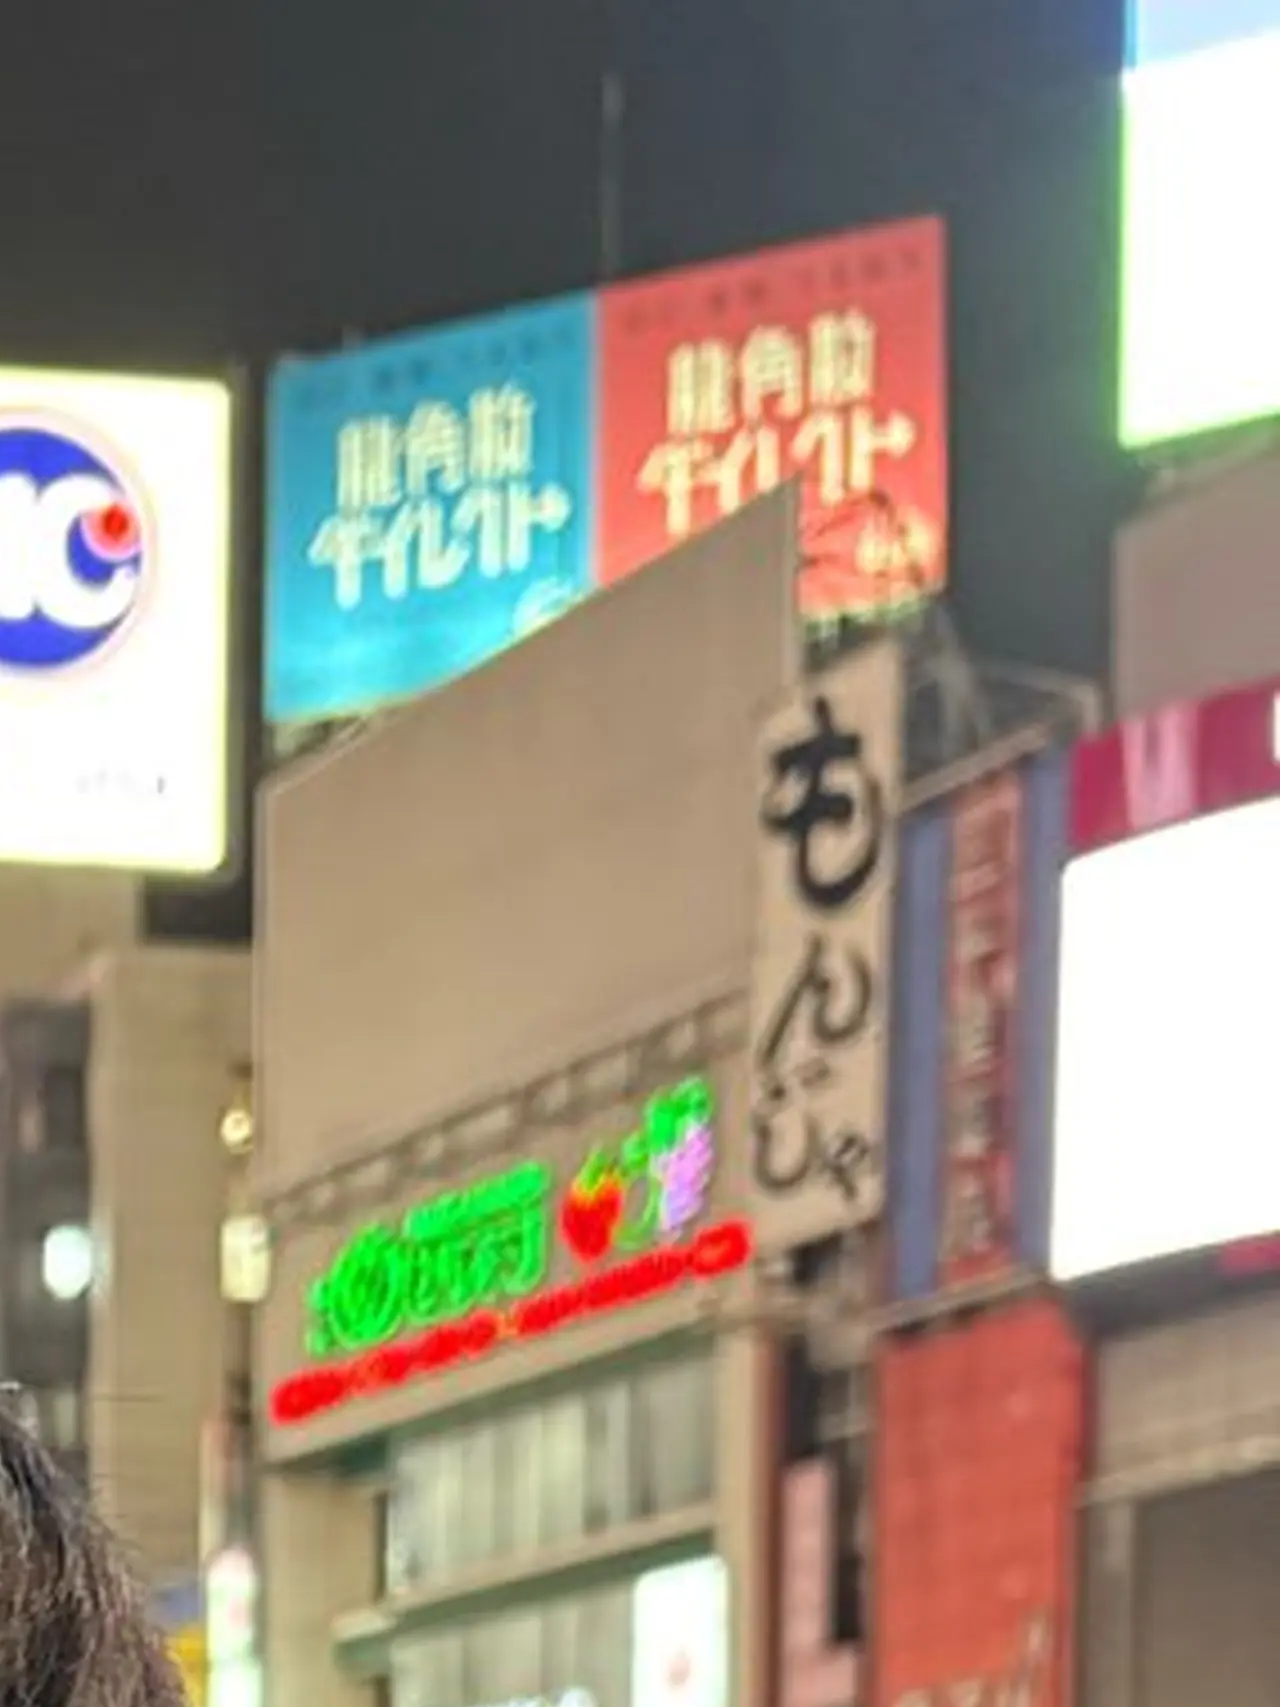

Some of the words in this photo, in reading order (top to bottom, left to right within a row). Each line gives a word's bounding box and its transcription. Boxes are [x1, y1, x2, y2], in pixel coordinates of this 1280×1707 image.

[306, 482, 571, 611] ダイレクト
[752, 696, 884, 1202] もんじゃ
